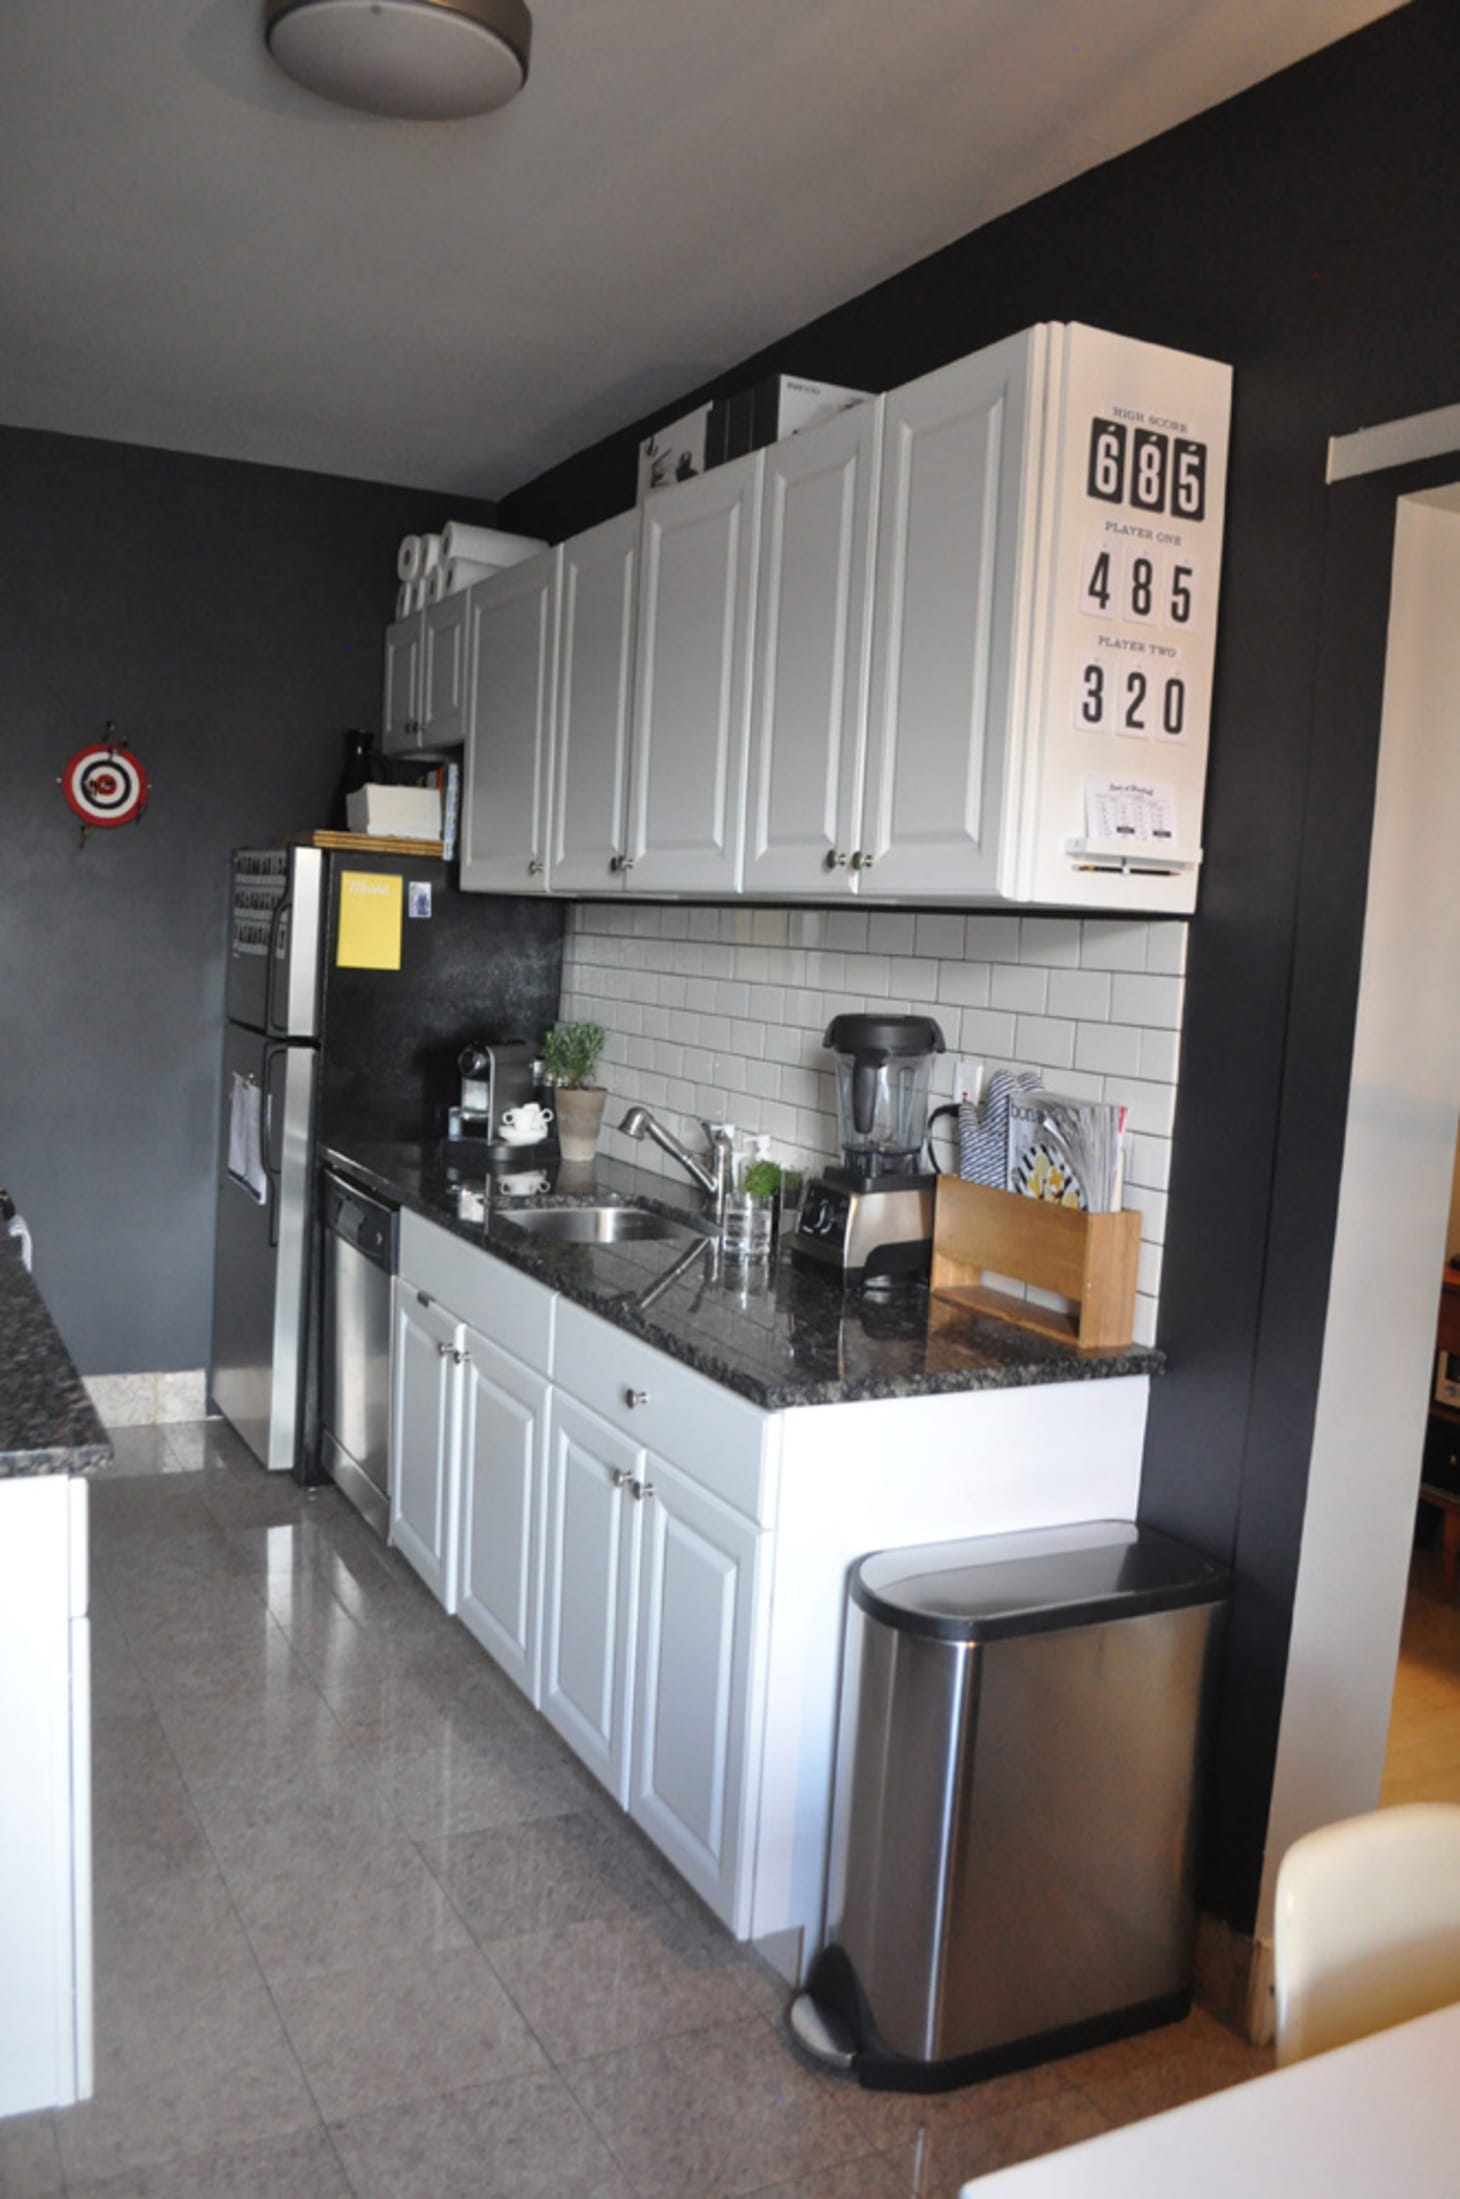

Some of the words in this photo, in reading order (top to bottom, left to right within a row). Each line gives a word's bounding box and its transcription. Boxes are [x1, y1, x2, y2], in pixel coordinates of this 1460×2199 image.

[1112, 406, 1144, 422] HIGH
[1148, 416, 1187, 433] SCORE
[1105, 520, 1153, 539] PLAYER
[1156, 532, 1182, 546] ONE
[1098, 635, 1146, 653] PLAYER
[1149, 644, 1177, 658] TWO
